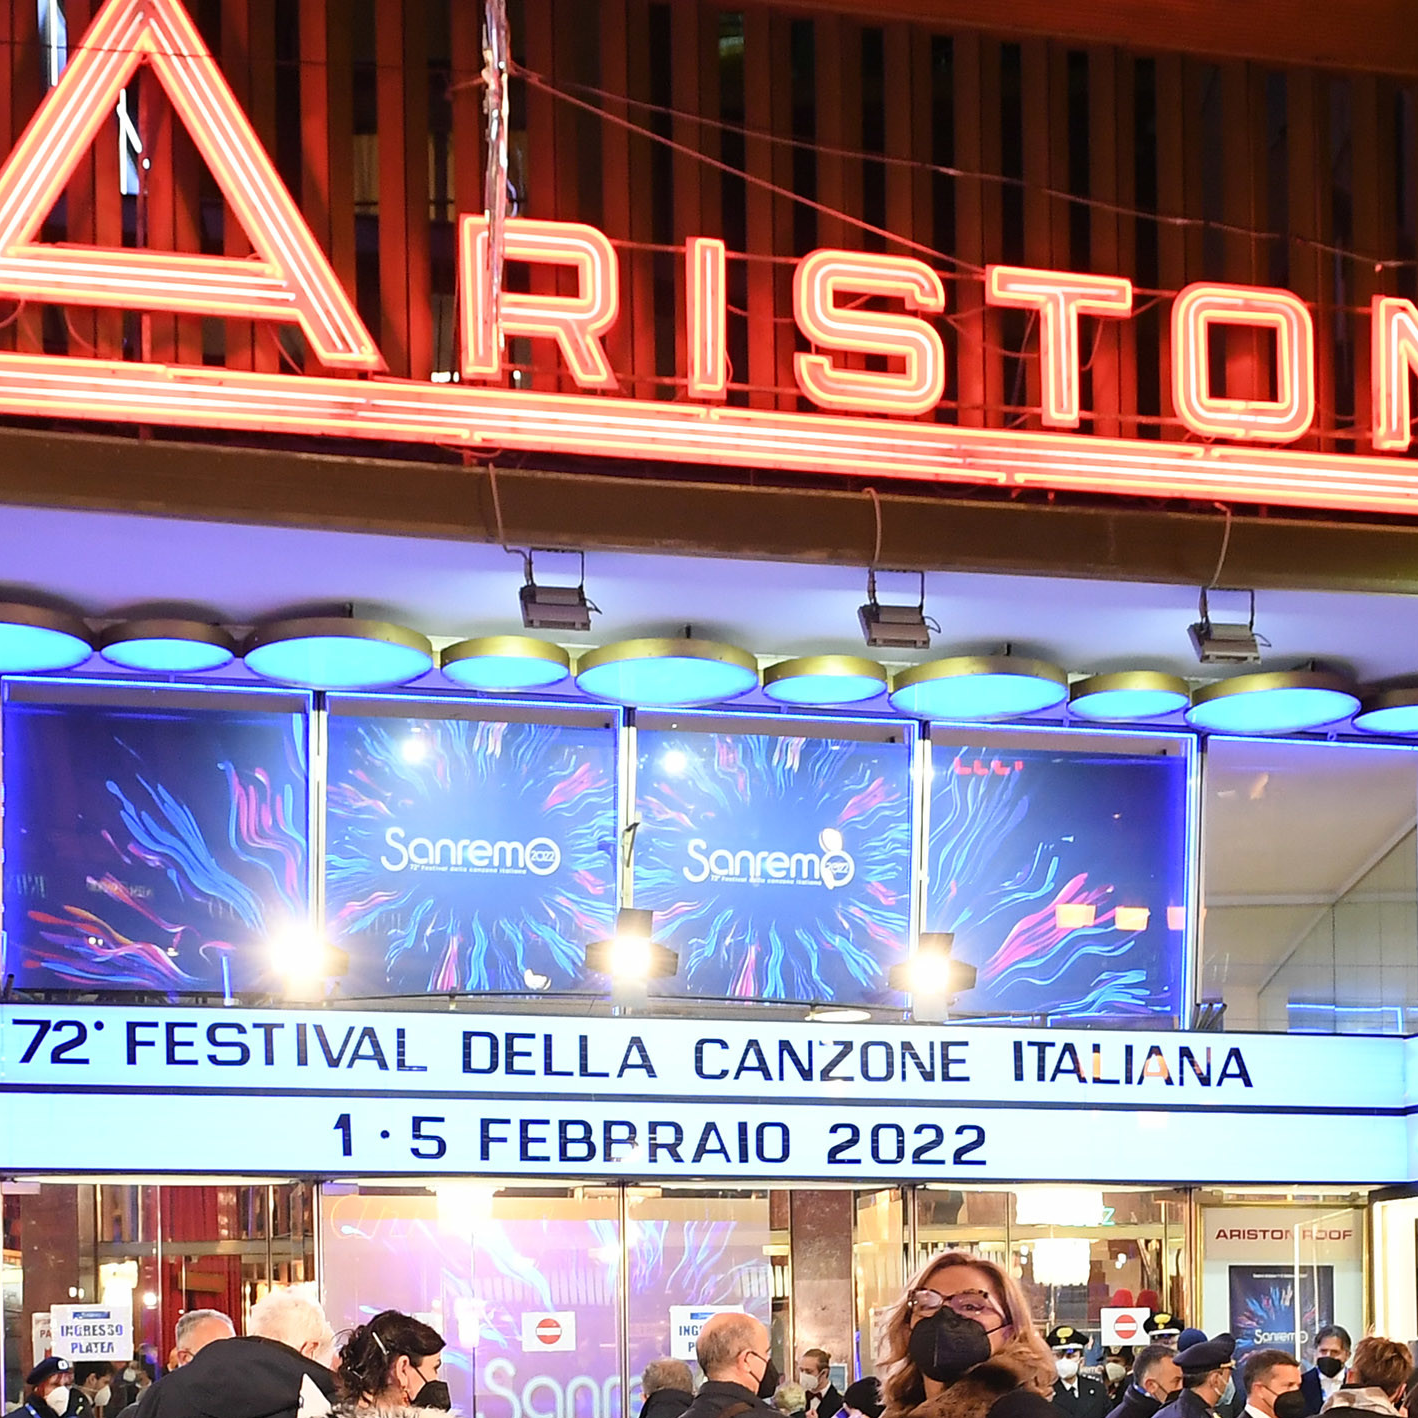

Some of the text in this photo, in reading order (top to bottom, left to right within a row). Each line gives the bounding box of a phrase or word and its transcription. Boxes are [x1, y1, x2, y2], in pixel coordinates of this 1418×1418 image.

[380, 826, 561, 876] Sanremo
[11, 1019, 1254, 1088] 72° FESTIVAL DELLA CANZONE ITALIANA
[480, 1118, 791, 1164] FEBBRAIO
[826, 1123, 987, 1166] 2022
[60, 1324, 123, 1337] INGRESSO
[71, 1341, 114, 1353] PLATEA
